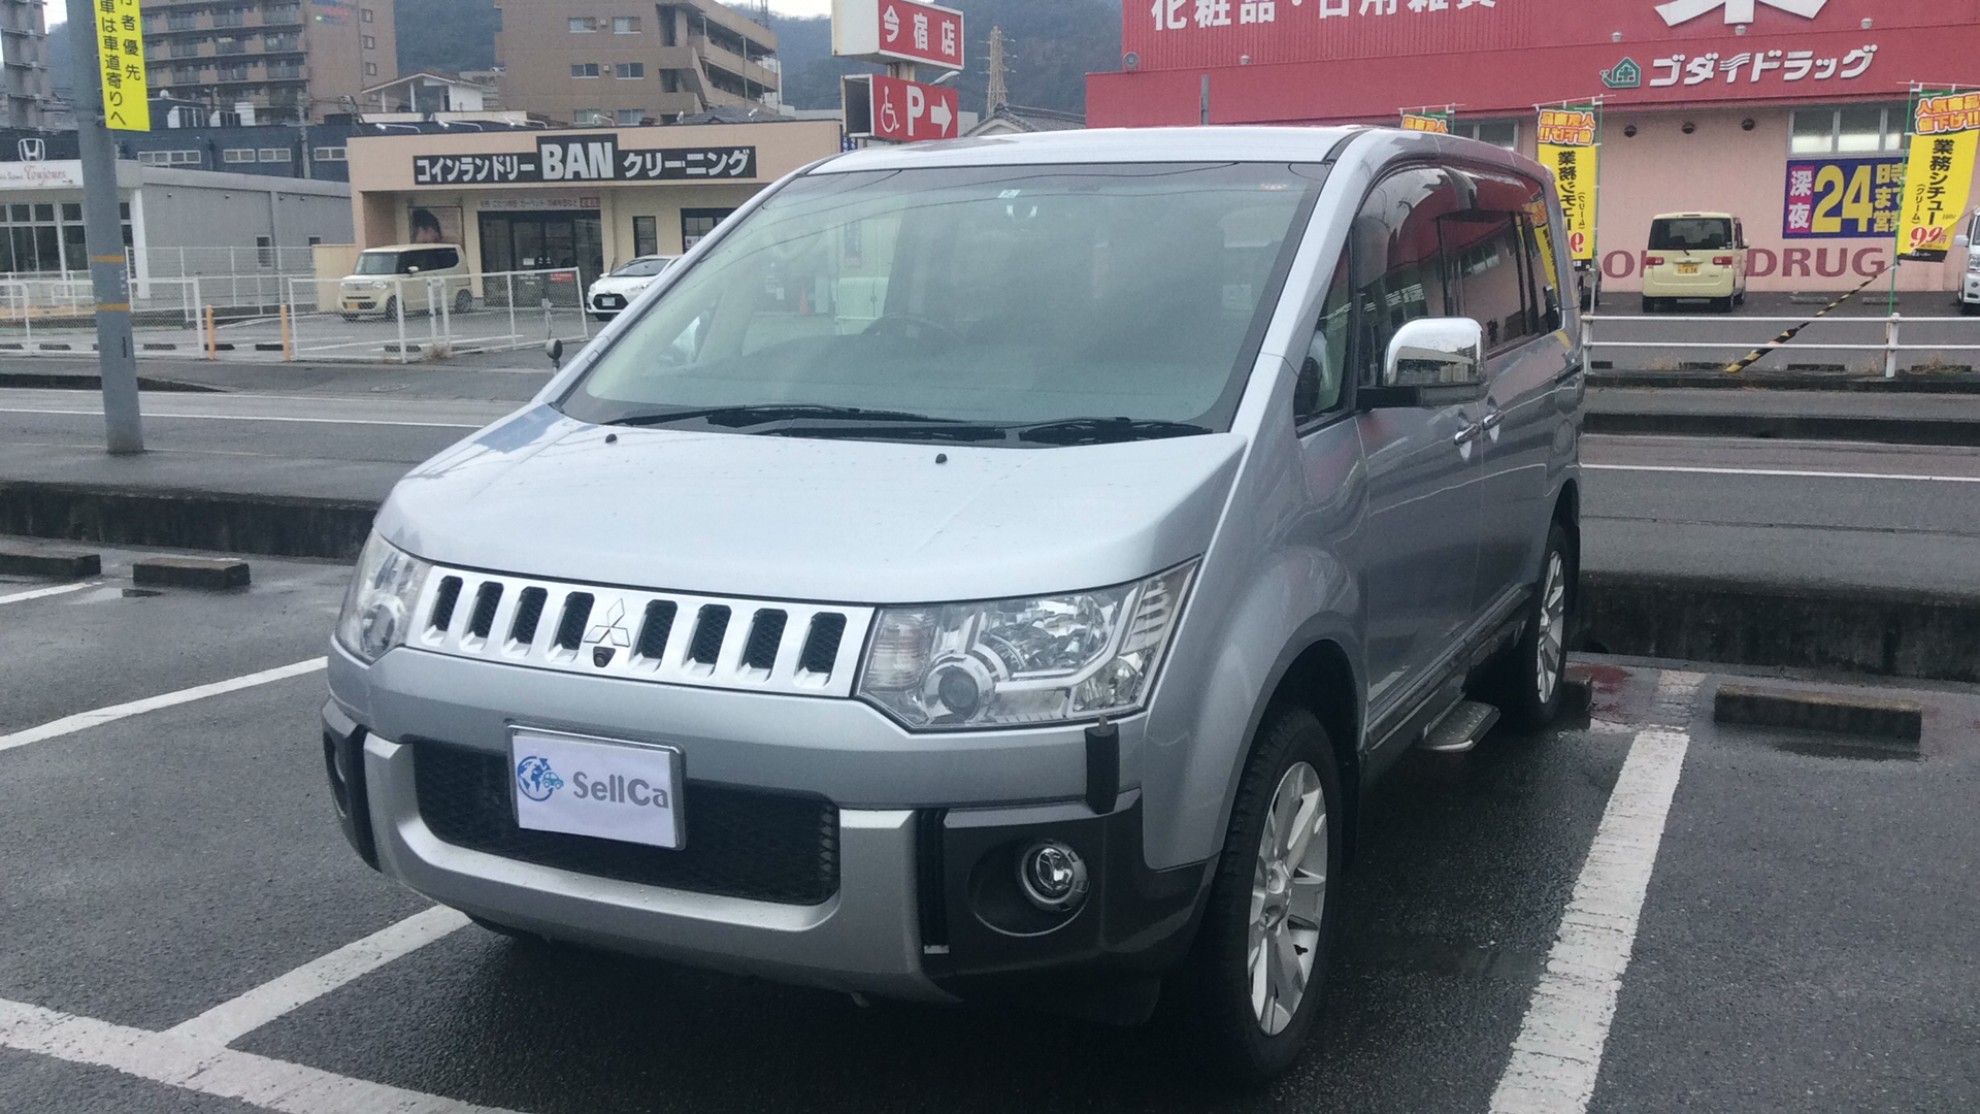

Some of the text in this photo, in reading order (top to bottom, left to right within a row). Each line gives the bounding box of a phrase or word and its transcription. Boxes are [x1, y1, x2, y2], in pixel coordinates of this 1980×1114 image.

[883, 4, 955, 56] 今宿店
[1649, 44, 1879, 87] ゴダイドラッグ
[906, 85, 925, 136] P
[416, 154, 536, 183] コインランドリー
[540, 141, 615, 181] BAN
[623, 148, 750, 178] クリーニング
[1926, 138, 1955, 226] 業務シチュー
[1789, 170, 1812, 230] 深夜
[1811, 164, 1875, 234] 24
[1746, 247, 1886, 278] DRUG
[573, 771, 669, 809] SellCa
